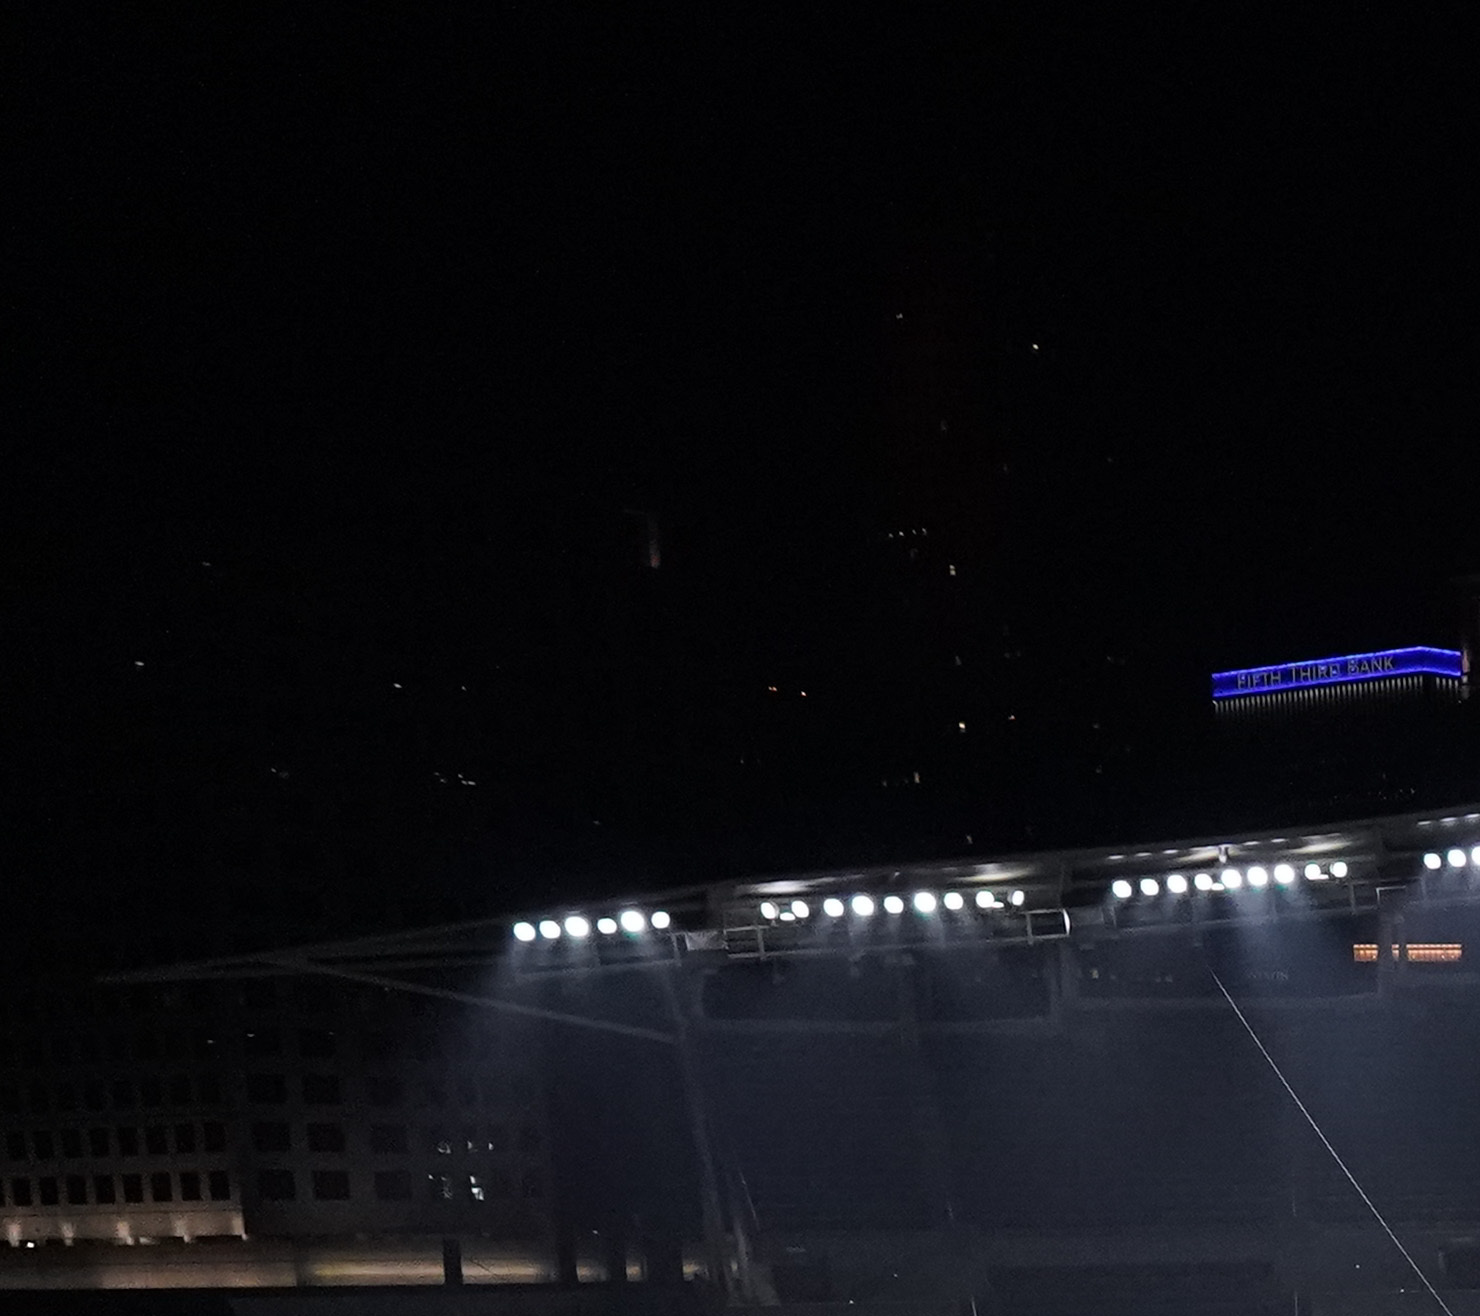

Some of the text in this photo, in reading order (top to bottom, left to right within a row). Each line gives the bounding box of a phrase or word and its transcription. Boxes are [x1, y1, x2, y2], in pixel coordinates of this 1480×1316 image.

[1237, 656, 1395, 690] FIFTH THIRD BANK
